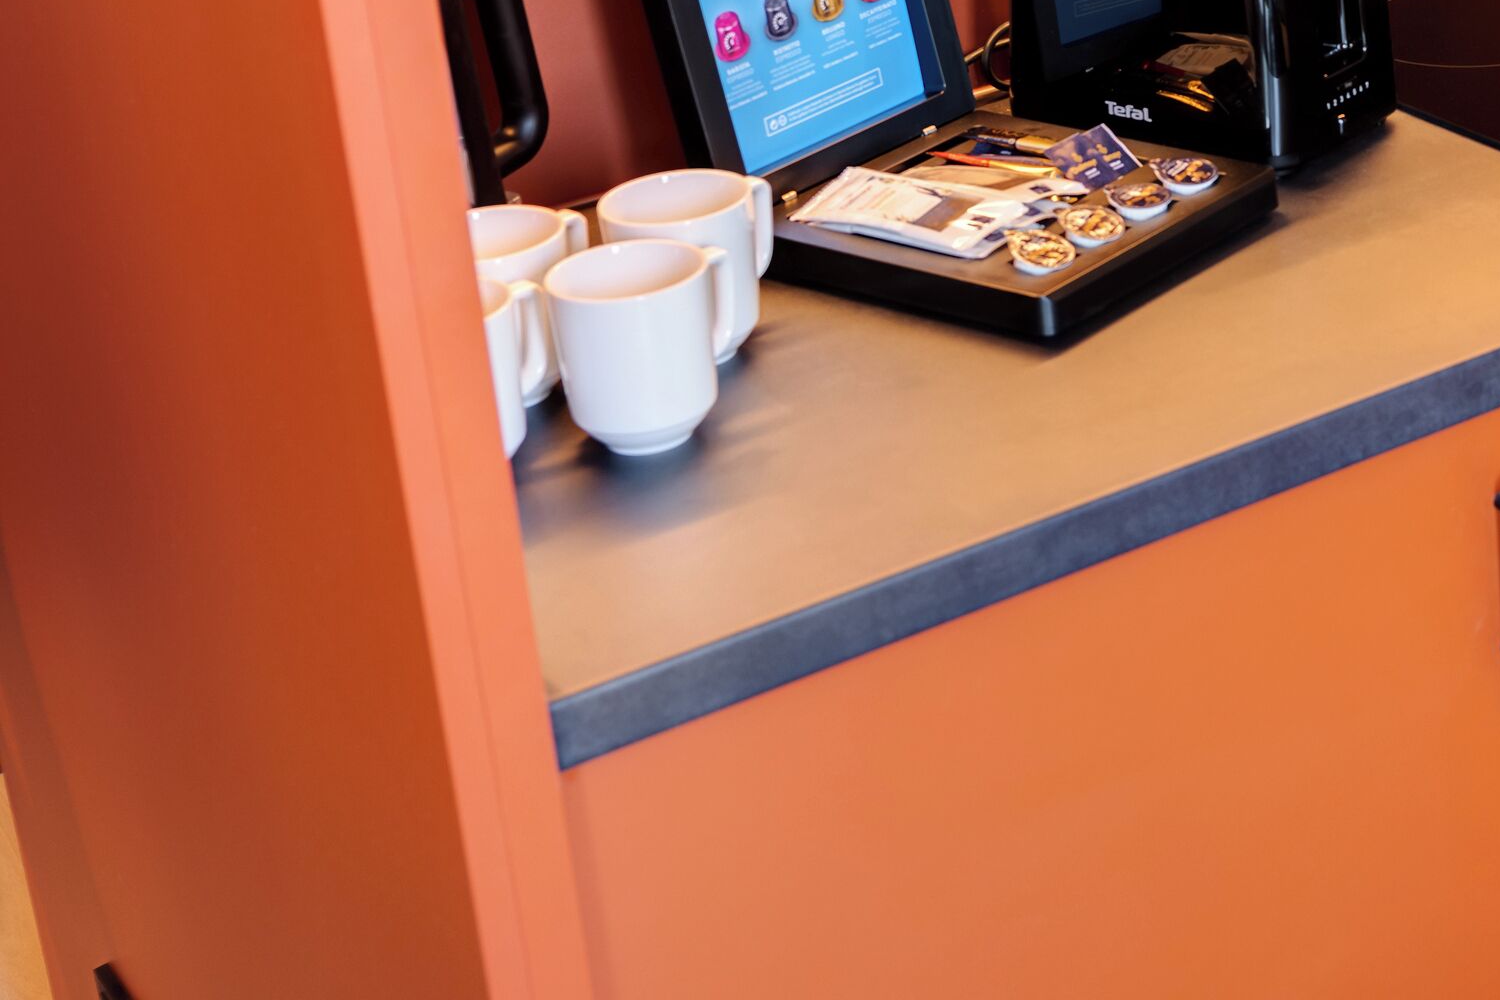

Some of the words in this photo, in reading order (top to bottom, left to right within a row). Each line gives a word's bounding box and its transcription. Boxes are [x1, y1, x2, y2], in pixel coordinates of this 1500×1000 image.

[1326, 102, 1331, 110] 1
[1332, 98, 1338, 107] 2
[1340, 95, 1344, 103] 3
[1346, 91, 1351, 99] 4
[1352, 87, 1357, 96] 5
[1358, 84, 1363, 92] 6
[1364, 81, 1370, 89] 7
[1104, 100, 1153, 122] Tefal
